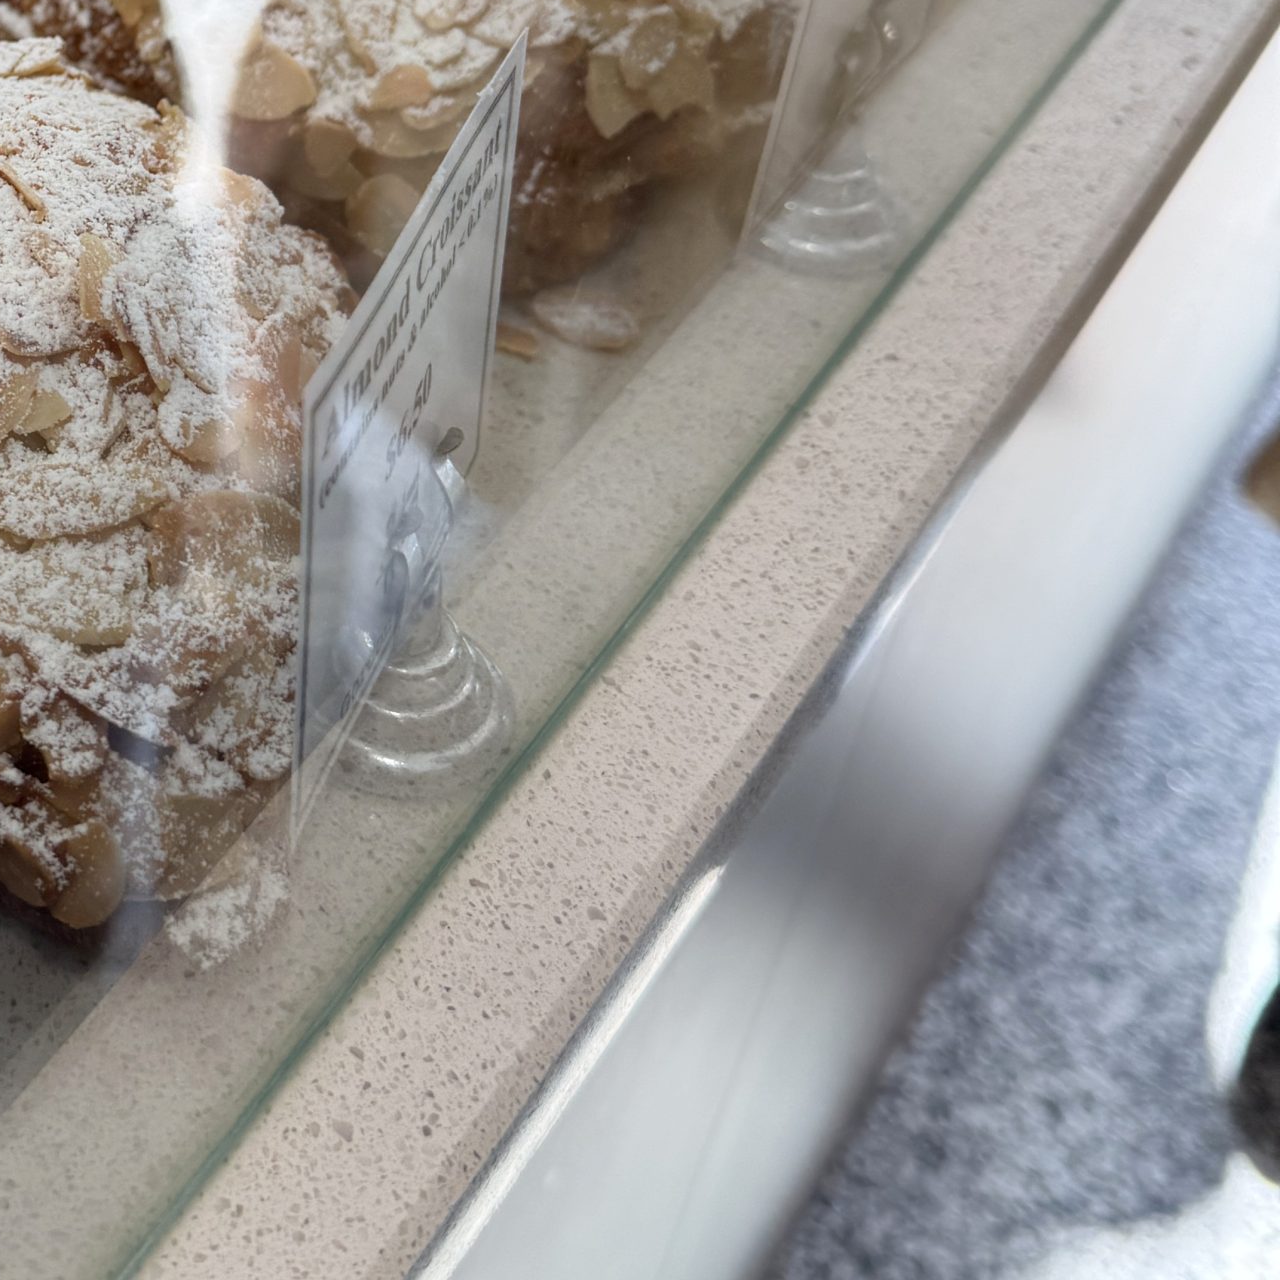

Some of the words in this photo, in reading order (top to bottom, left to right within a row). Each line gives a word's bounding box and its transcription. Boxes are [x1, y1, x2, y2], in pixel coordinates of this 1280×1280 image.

[322, 275, 410, 460] Almond
[416, 117, 502, 291] Croissant
[382, 349, 405, 403] nuts
[420, 244, 457, 329] alcohol
[384, 362, 433, 483] $6.50
